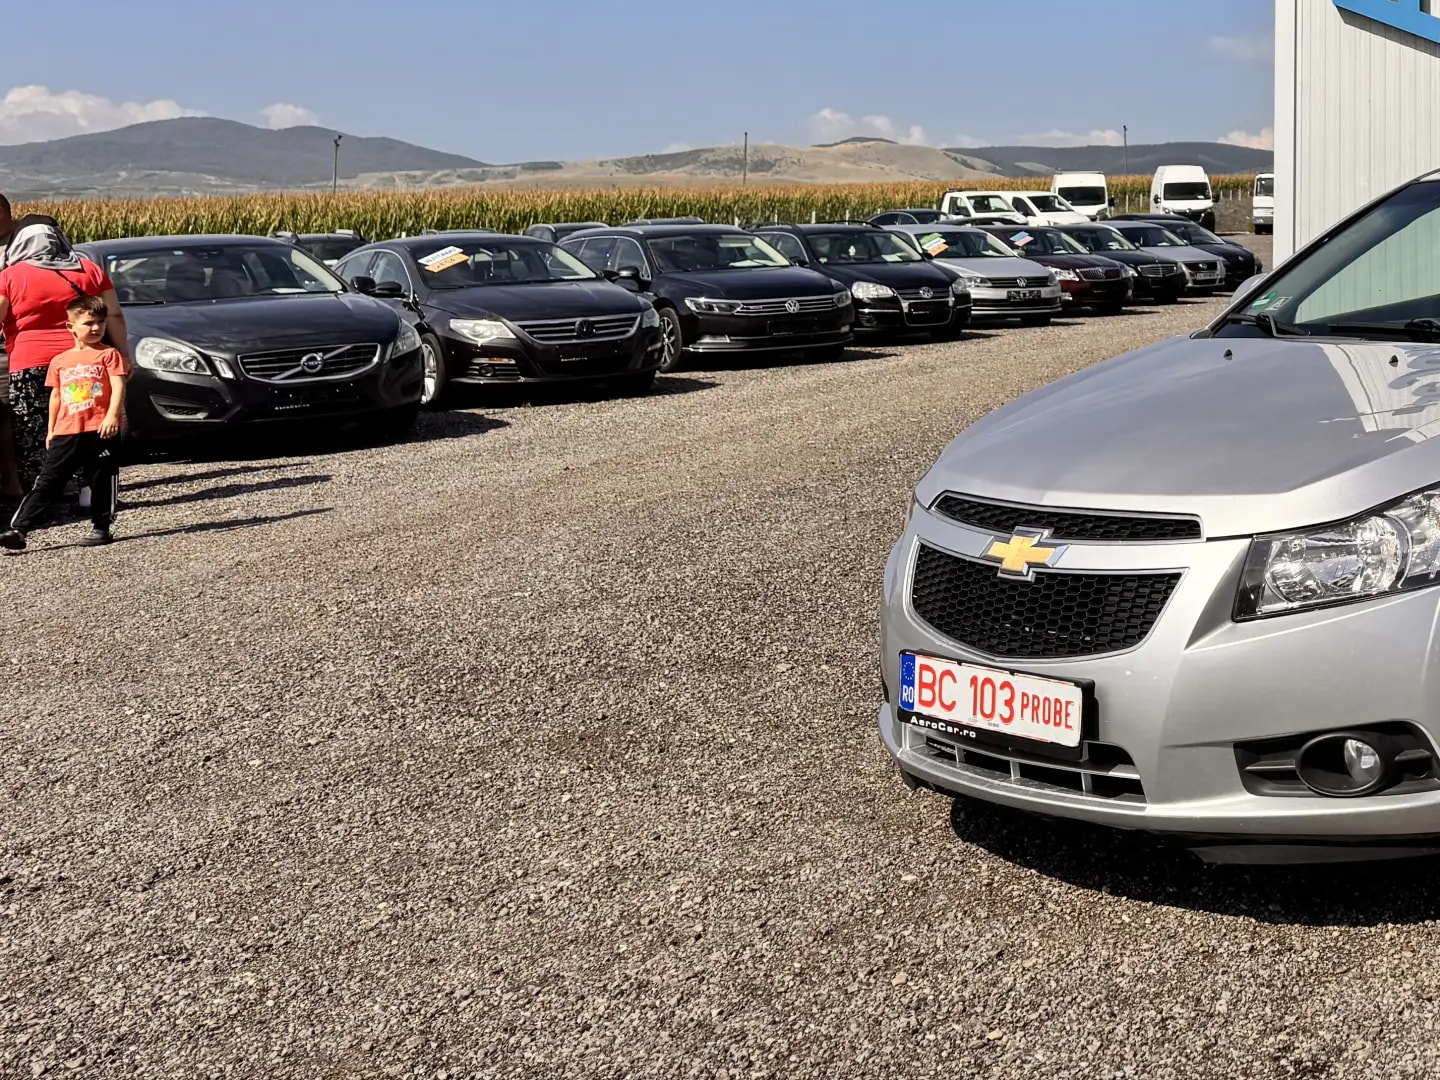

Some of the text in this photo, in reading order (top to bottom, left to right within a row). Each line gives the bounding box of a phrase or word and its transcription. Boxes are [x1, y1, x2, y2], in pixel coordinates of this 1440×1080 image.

[902, 685, 914, 704] RO
[918, 663, 1074, 731] BC 103 PROBE
[910, 715, 977, 739] AeroCar.ro
